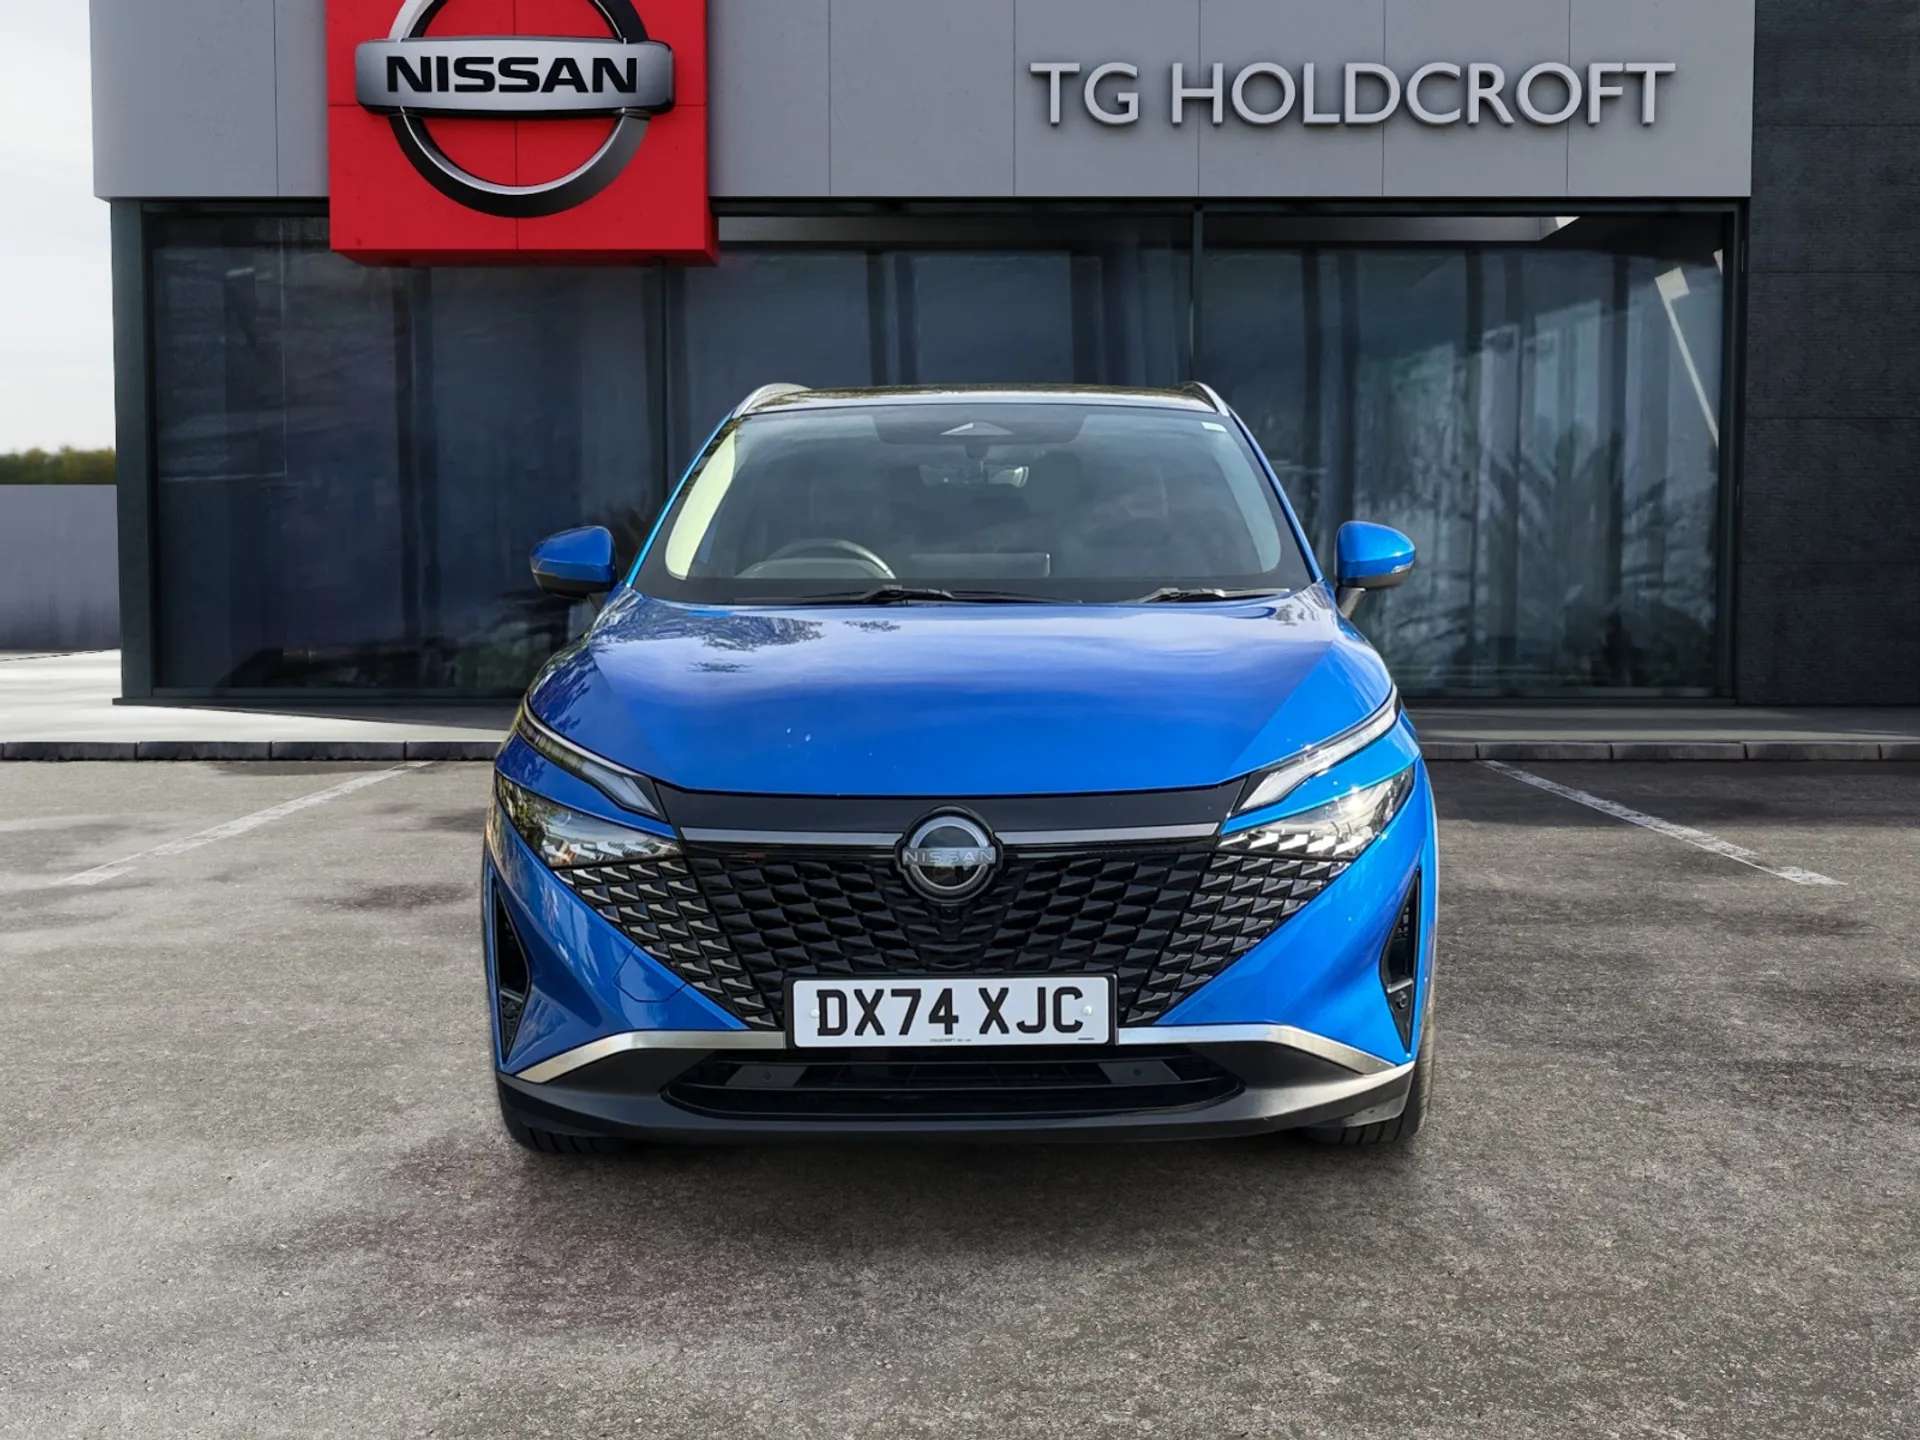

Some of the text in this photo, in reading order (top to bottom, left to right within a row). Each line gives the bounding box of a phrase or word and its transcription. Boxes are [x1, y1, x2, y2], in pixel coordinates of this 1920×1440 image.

[387, 56, 637, 93] NISSAN
[1030, 62, 1676, 126] TG HOLDCROFT
[904, 850, 994, 863] NISSAN
[816, 987, 1083, 1036] DX74 XJC
